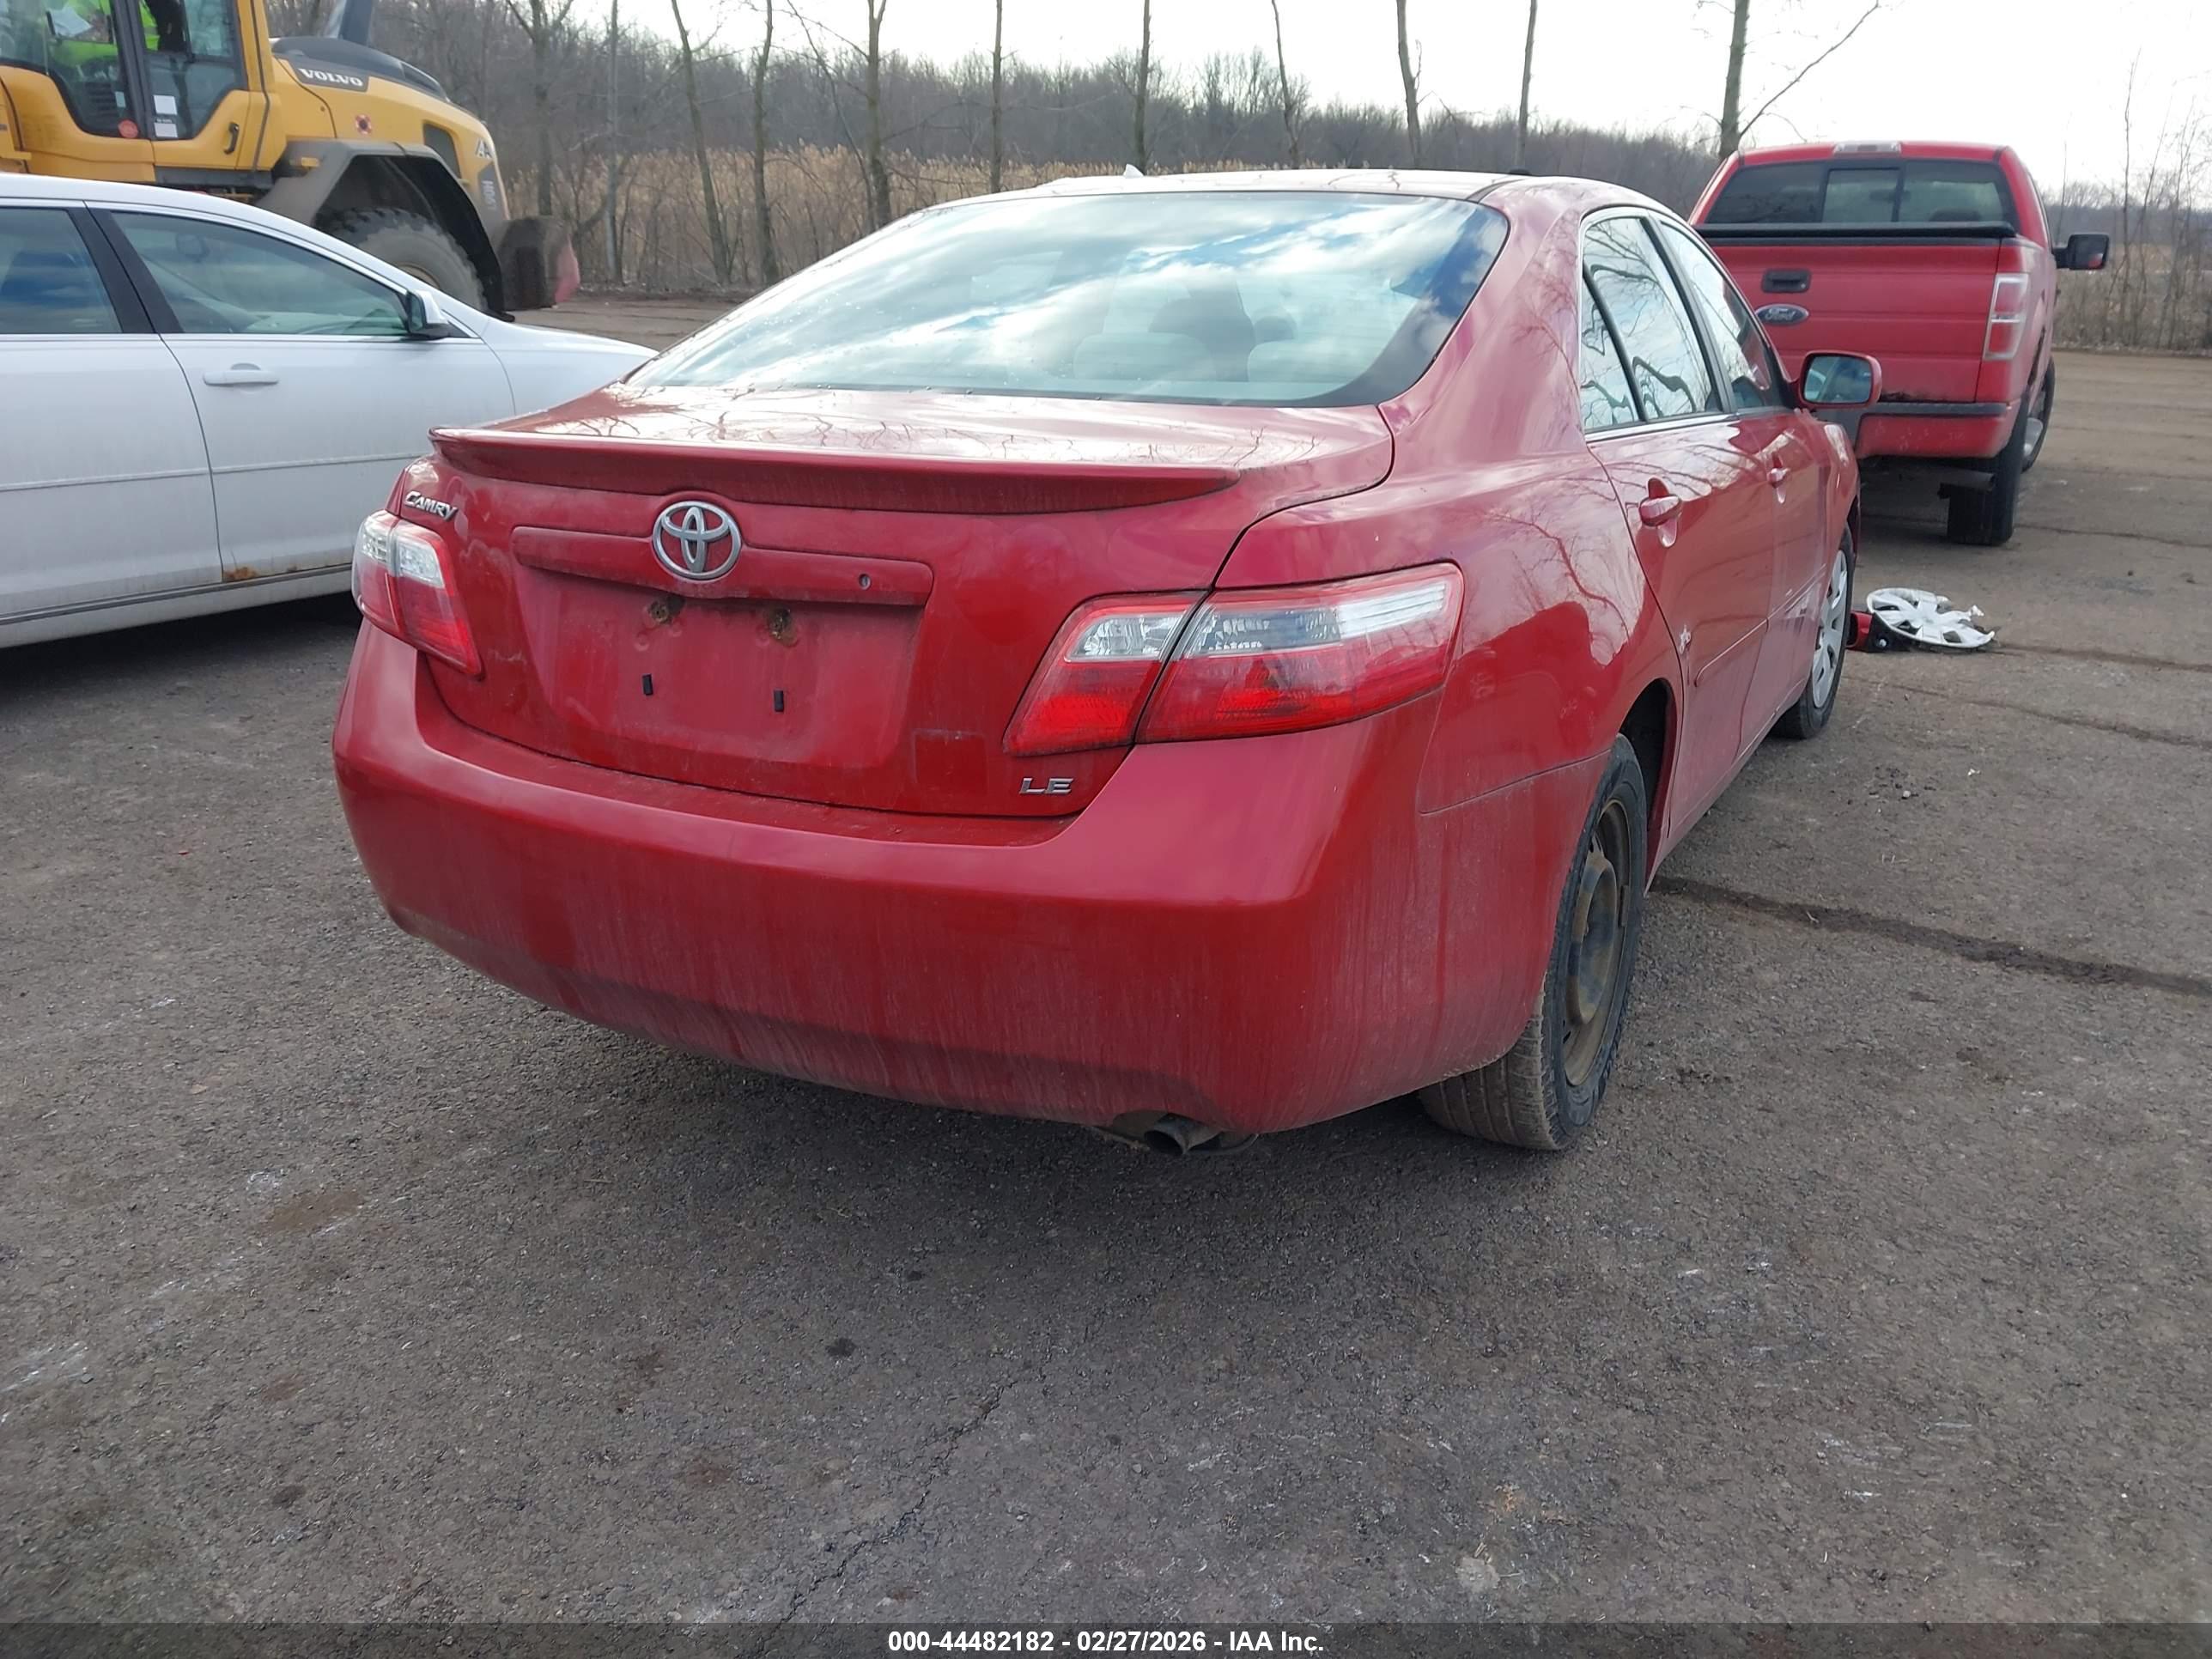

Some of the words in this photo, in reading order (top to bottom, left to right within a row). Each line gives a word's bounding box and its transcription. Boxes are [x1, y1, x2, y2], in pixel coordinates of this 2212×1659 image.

[298, 68, 363, 87] VOLVO
[1765, 307, 1797, 321] Ford
[404, 490, 459, 521] CAMRY
[1019, 777, 1074, 794] LE
